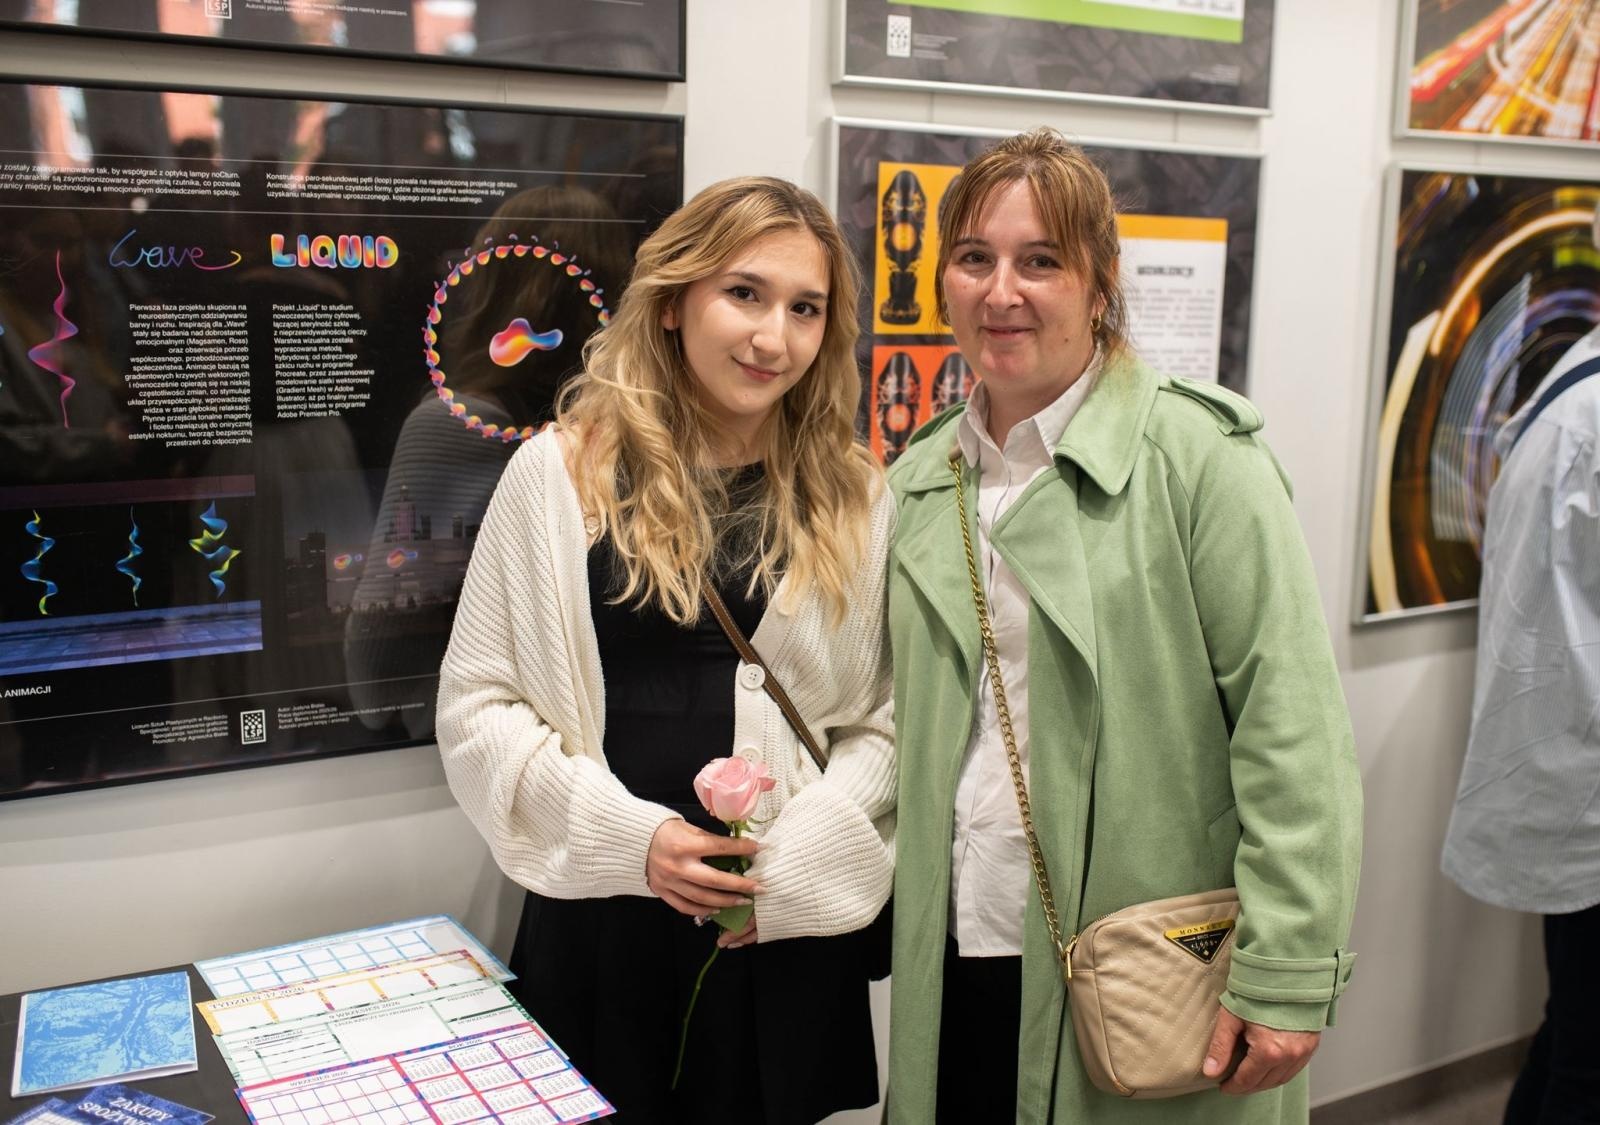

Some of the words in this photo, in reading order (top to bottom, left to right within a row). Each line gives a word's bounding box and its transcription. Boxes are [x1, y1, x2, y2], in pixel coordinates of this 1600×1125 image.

[4, 164, 30, 173] zostały
[111, 167, 120, 176] by
[121, 167, 157, 177] współgrać
[164, 169, 187, 178] optyką
[189, 170, 209, 179] lampy
[15, 173, 50, 181] charakter
[62, 174, 128, 185] zsynchronizowane
[136, 177, 171, 186] geometrią
[212, 179, 241, 188] pozwala
[24, 183, 51, 192] między
[52, 183, 94, 193] technologią
[102, 185, 153, 195] emocjonalnym
[155, 186, 211, 194] doświadczeniem
[110, 229, 242, 270] Wave
[271, 234, 398, 268] LIQUID
[178, 304, 205, 312] projektu
[207, 303, 236, 312] skupiona
[272, 304, 295, 312] Projekt
[138, 312, 199, 321] neuroestetycznym
[200, 312, 247, 320] oddziaływaniu
[273, 312, 313, 320] nowoczesnej
[315, 312, 332, 320] formy
[130, 321, 150, 329] barwy
[178, 320, 210, 329] Inspiracją
[133, 329, 148, 338] stały
[150, 329, 160, 338] się
[279, 328, 346, 337] nieprzewidywalnością
[136, 337, 184, 346] emocjonalnym
[184, 345, 222, 354] obserwacja
[224, 345, 249, 354] potrzeb
[318, 344, 342, 353] metodą
[321, 352, 358, 361] odręcznego
[185, 362, 216, 371] Animacje
[217, 362, 239, 371] bazują
[322, 360, 354, 369] programie
[125, 371, 173, 381] gradientowych
[175, 371, 206, 380] krzywych
[207, 370, 250, 379] wektorowych
[336, 376, 370, 385] wektorowej
[180, 379, 206, 388] opierają
[208, 379, 218, 388] się
[229, 378, 250, 387] niskiej
[219, 386, 251, 396] stymuluje
[276, 385, 305, 394] (Gradient
[306, 385, 326, 394] Mesh)
[204, 395, 251, 404] wprowadzając
[326, 392, 346, 402] finalny
[335, 400, 366, 410] programie
[142, 414, 165, 423] Płynne
[167, 413, 196, 422] przejścia
[223, 411, 252, 421] magenty
[175, 421, 207, 430] nawiązują
[219, 420, 252, 429] onirycznej
[128, 431, 154, 440] estetyki
[188, 429, 214, 438] tworząc
[215, 428, 252, 438] bezpieczną
[166, 438, 200, 448] przestrzeń
[4, 685, 51, 698] ANIMACJI
[245, 728, 262, 738] LSP
[110, 1096, 173, 1122] ZAKUPY
